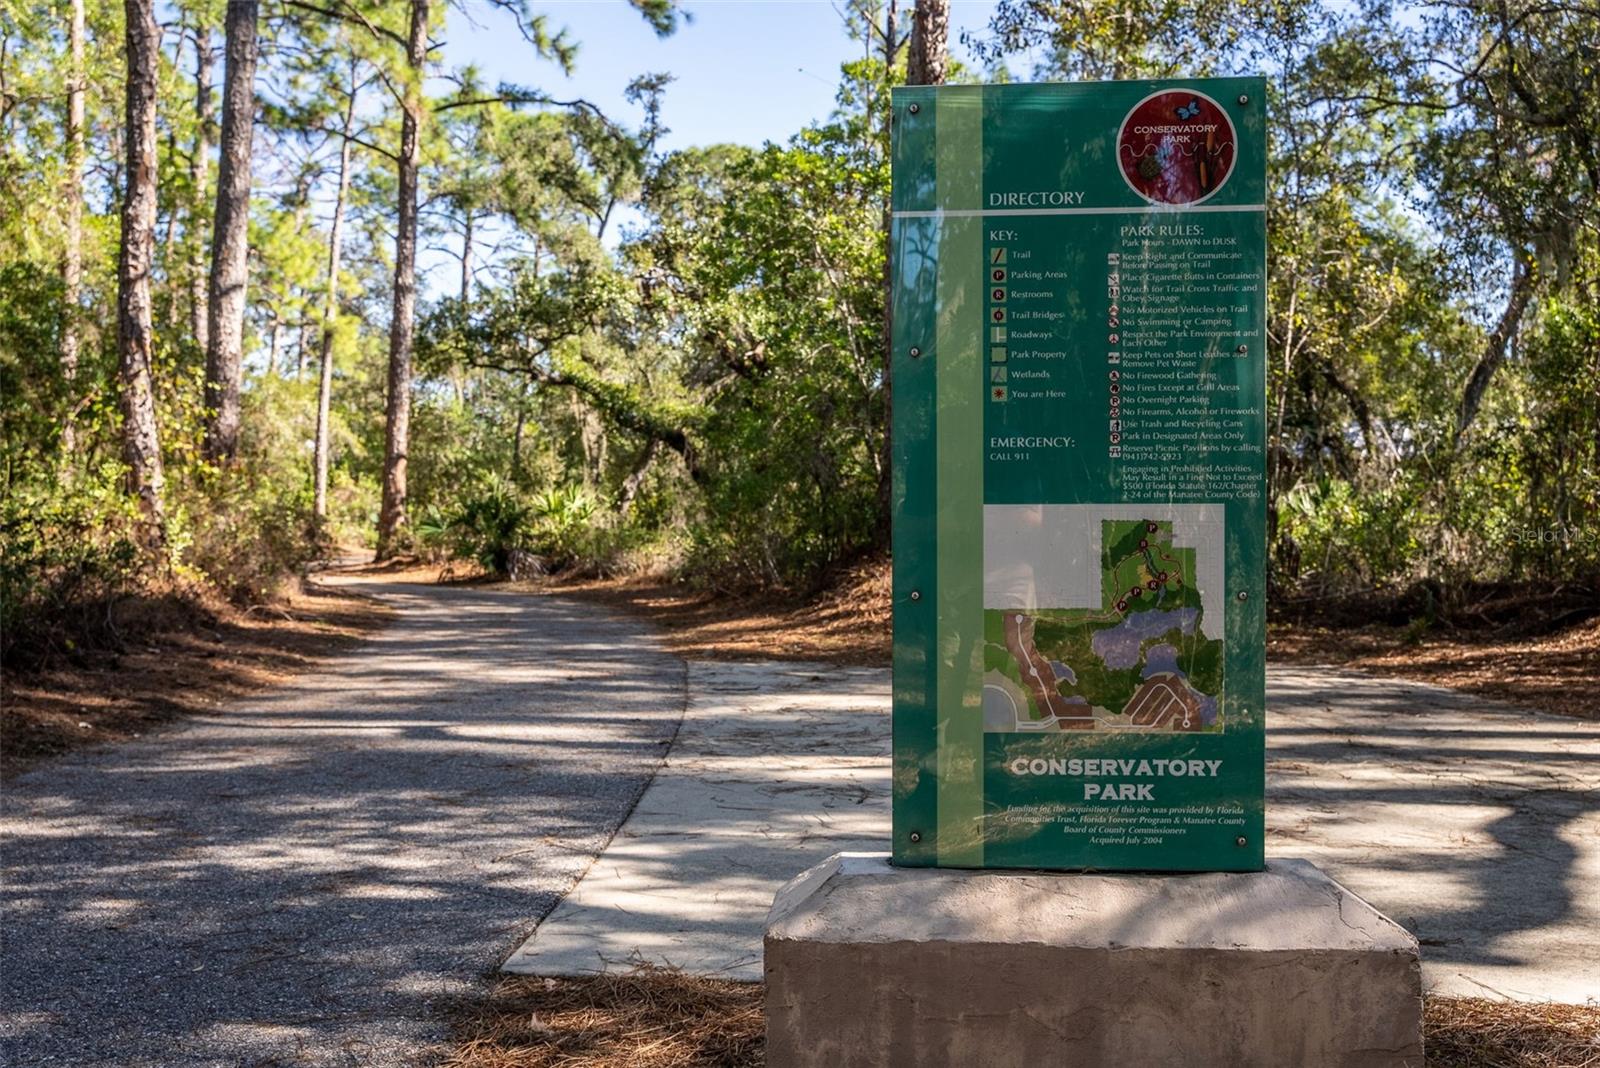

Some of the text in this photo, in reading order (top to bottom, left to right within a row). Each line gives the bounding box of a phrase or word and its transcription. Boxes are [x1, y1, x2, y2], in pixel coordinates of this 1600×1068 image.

[1134, 125, 1217, 134] CONSERVATORY
[1163, 135, 1191, 143] PARK
[990, 192, 1085, 206] DIRECTORY
[1121, 225, 1204, 236] PARK RULES:
[990, 231, 1018, 240] KEY:
[1122, 252, 1242, 262] Keep Right and Communicate
[1150, 262, 1178, 270] Passing
[1011, 271, 1042, 279] Parking
[1122, 273, 1144, 281] Place
[1146, 272, 1182, 282] Cigarette
[1216, 272, 1260, 280] Containers
[1122, 285, 1149, 293] Watch
[1242, 284, 1258, 292] and
[1122, 294, 1180, 304] Obey Signage
[1032, 312, 1065, 320] Bridges
[1138, 319, 1180, 327] Swimming
[1195, 318, 1232, 326] Camping
[1011, 331, 1052, 340] Roadways
[1123, 331, 1152, 339] Respect
[1243, 329, 1258, 337] and
[1032, 351, 1066, 359] Property
[1123, 352, 1142, 360] Keep
[1177, 372, 1217, 380] Gathering
[1159, 384, 1184, 393] Except
[1137, 396, 1177, 405] Overnight
[1180, 396, 1210, 405] Parking
[1182, 420, 1221, 428] Recycling
[1223, 419, 1243, 427] Cans
[1153, 432, 1197, 442] Designated
[1224, 432, 1244, 440] Only
[991, 437, 1075, 448] EMERGENCY:
[1122, 444, 1262, 453] Reserve Picnic Pavilions by calling
[1122, 464, 1252, 474] Engaging Prohibited Activities
[1122, 474, 1140, 482] May
[1142, 473, 1166, 481] Result
[1186, 473, 1204, 481] Fine
[1233, 472, 1262, 480] Exceed
[1122, 481, 1256, 491] $500 (Florida Statute 162/Chapter
[1122, 490, 1260, 500] 2-24 of the Manatee County Code)
[1011, 759, 1223, 776] CONSERVATORY
[1084, 784, 1155, 800] PARK
[1008, 804, 1038, 814] Funding
[1052, 804, 1066, 814] the
[1067, 805, 1109, 814] acquisition
[1120, 806, 1136, 814] this
[1137, 806, 1150, 814] site
[1169, 806, 1205, 815] provided
[1206, 806, 1214, 816] by
[1216, 806, 1244, 814] Florida
[1057, 816, 1078, 824] Trust,
[1080, 815, 1107, 824] Florida
[1108, 816, 1137, 824] Forever
[1140, 816, 1172, 825] Program
[1182, 816, 1216, 824] Manatee
[1218, 817, 1246, 826] County
[1064, 826, 1186, 835] Board County Commissioners
[1089, 836, 1163, 845] Acquired July 2004
